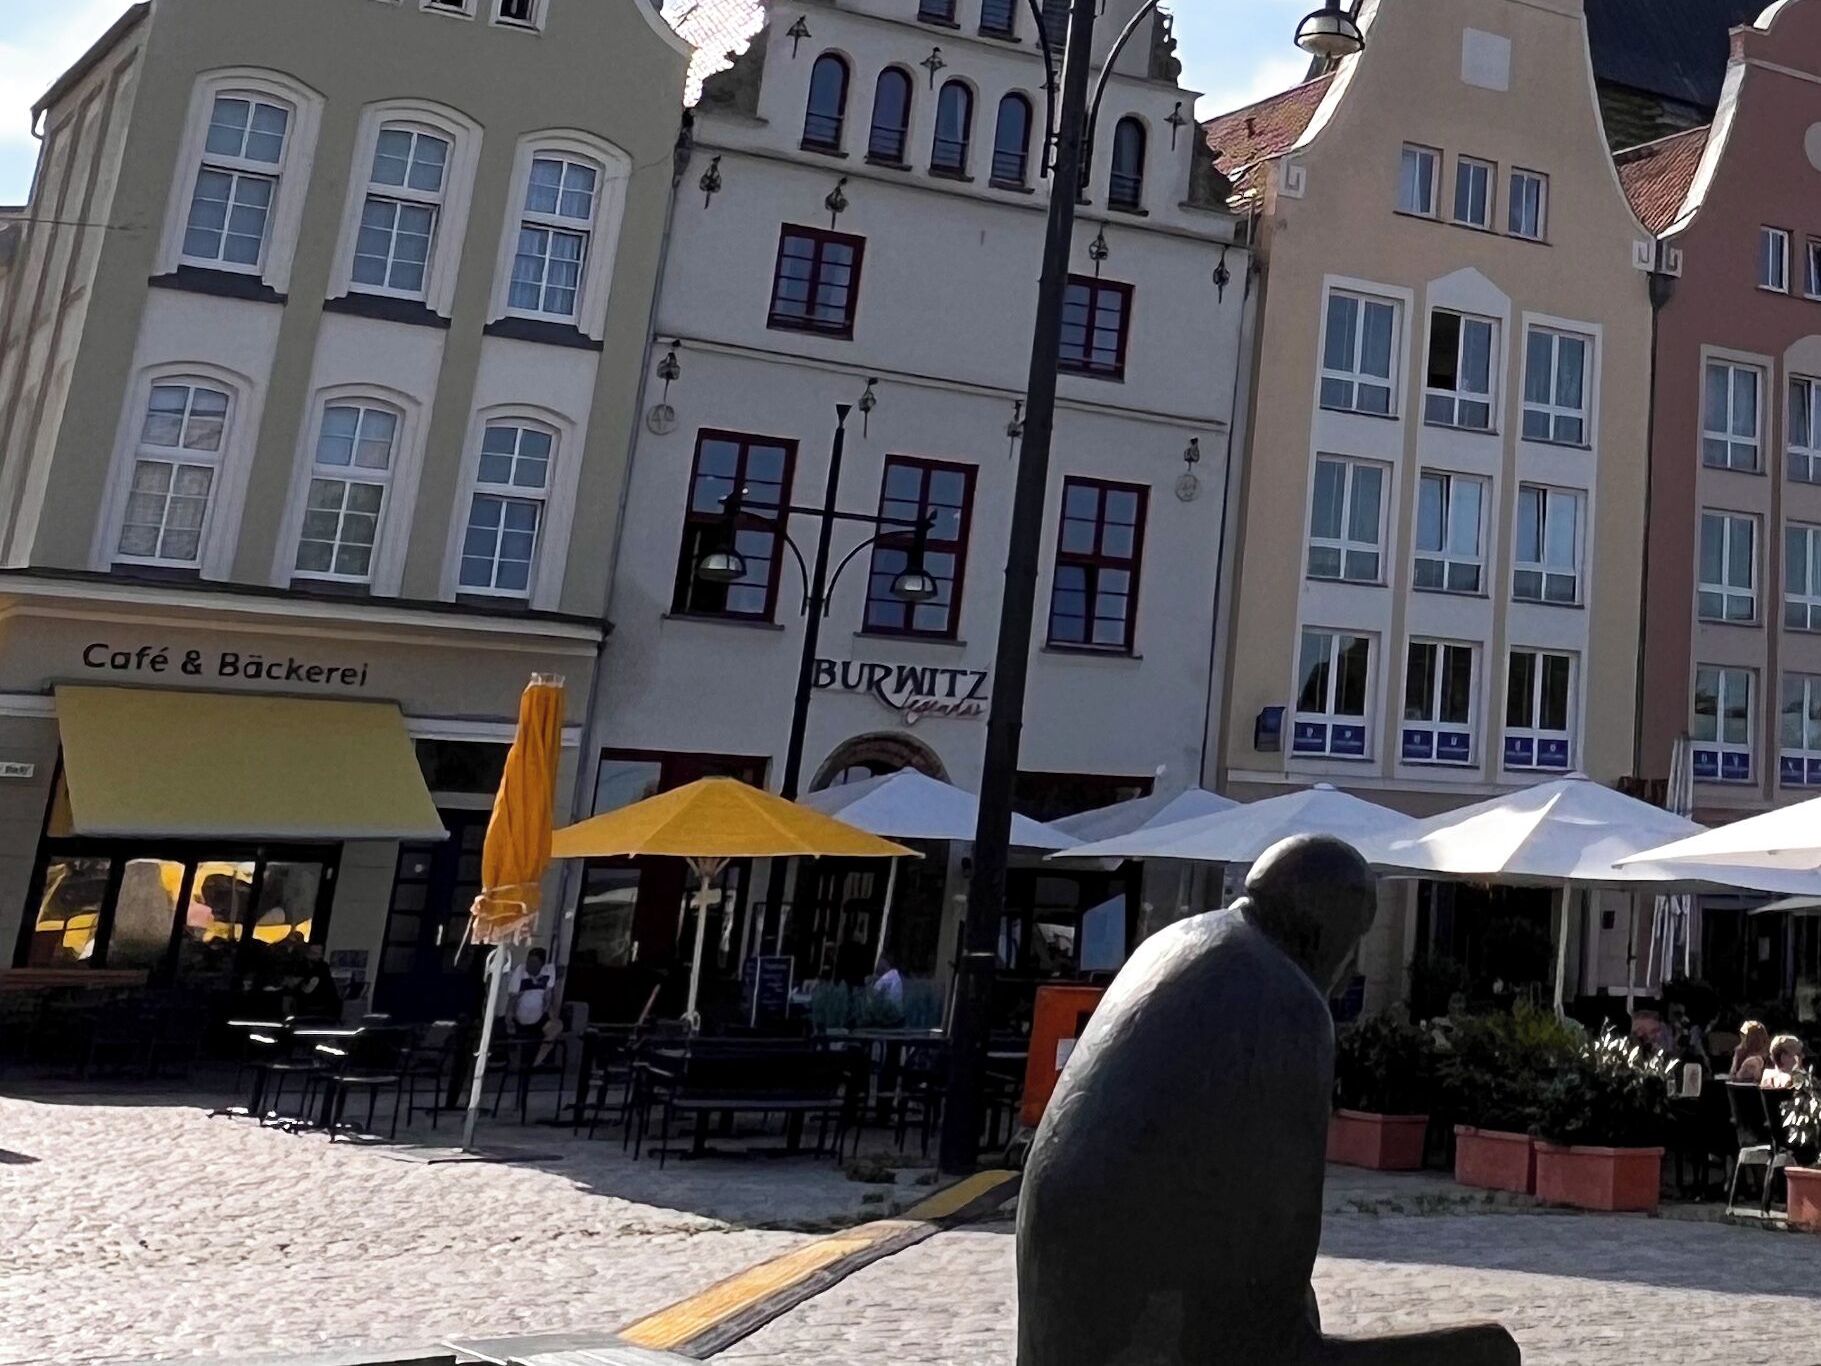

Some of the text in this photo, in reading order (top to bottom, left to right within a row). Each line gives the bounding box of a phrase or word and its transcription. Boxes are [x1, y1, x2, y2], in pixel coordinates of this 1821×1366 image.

[83, 643, 368, 686] Café & Bäckerei
[813, 659, 988, 709] BURWITZ
